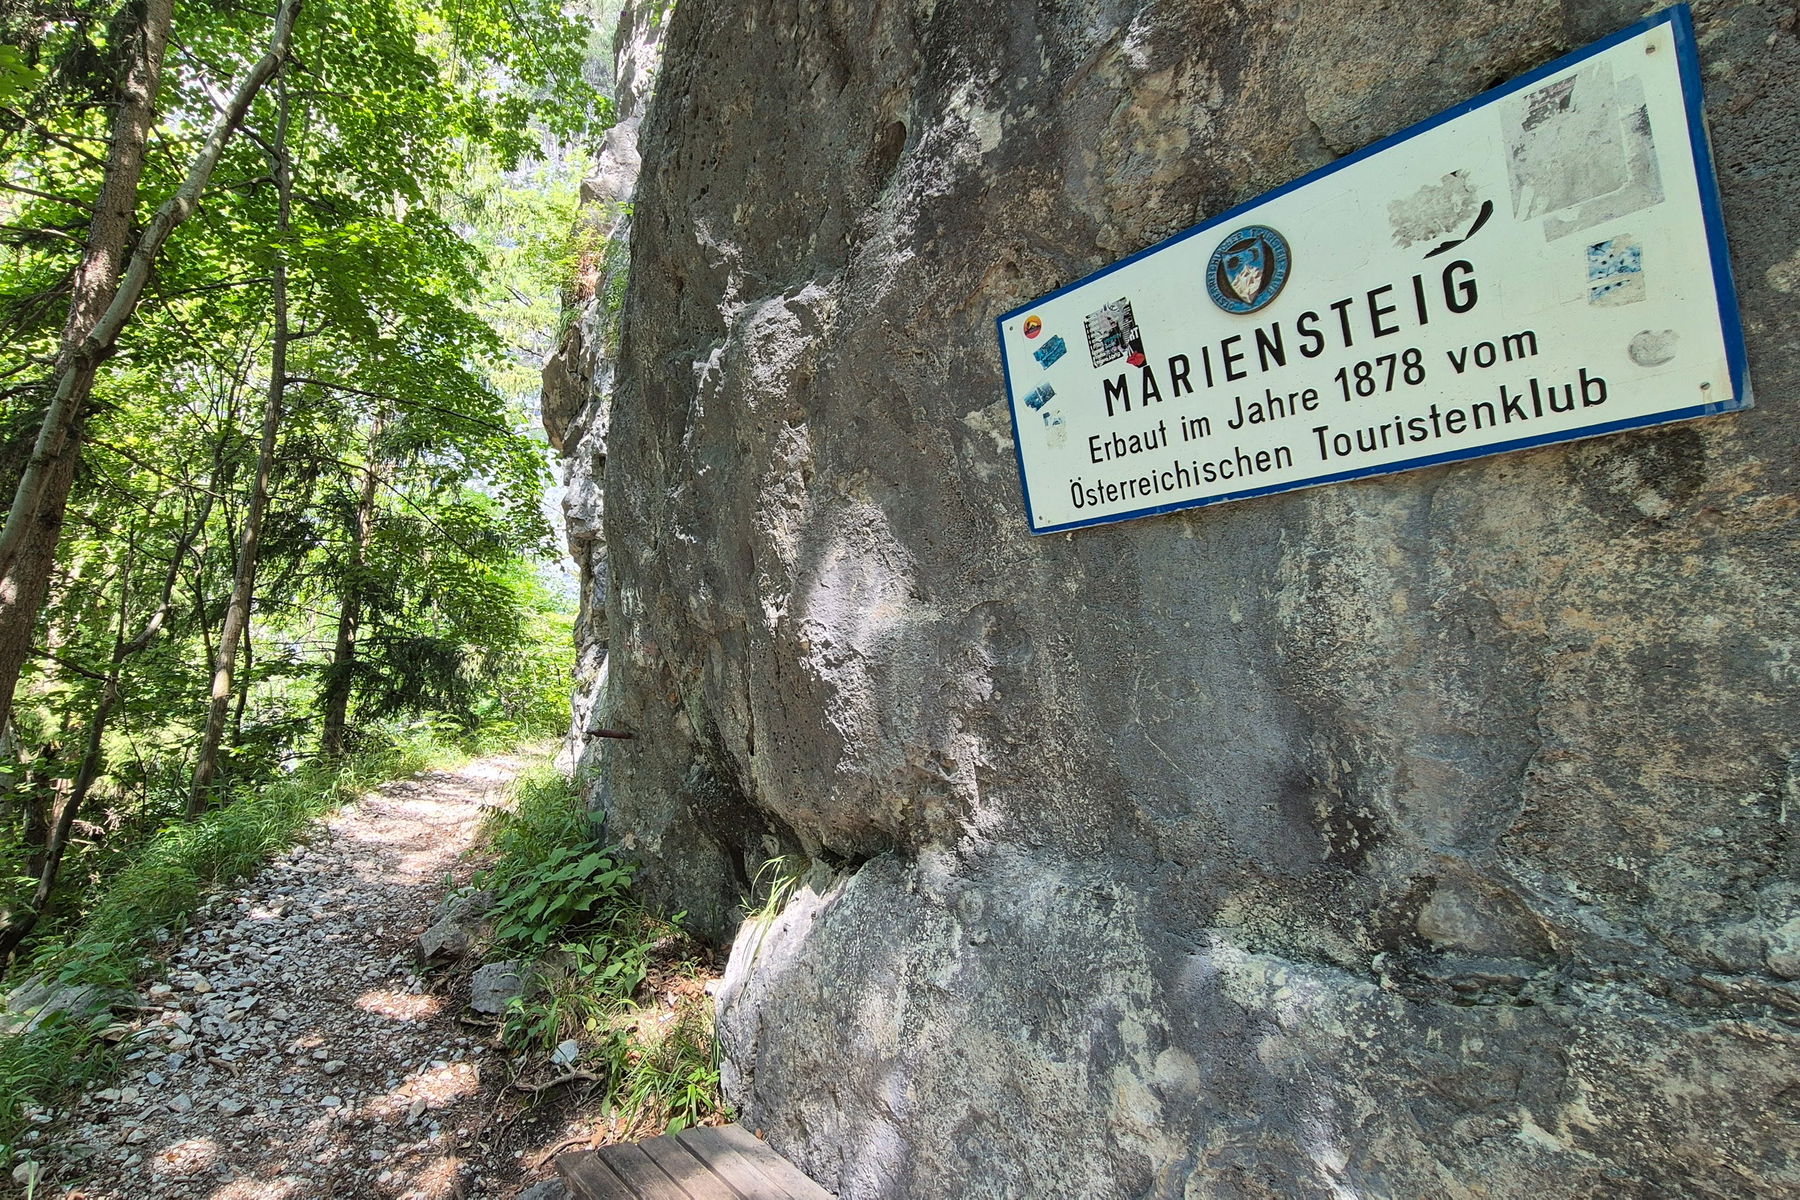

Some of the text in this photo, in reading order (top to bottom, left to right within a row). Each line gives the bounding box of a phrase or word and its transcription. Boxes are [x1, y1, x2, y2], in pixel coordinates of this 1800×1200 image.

[1088, 329, 1539, 464] Erbaut im Jahre 1878 vom
[1102, 258, 1478, 417] MARIENSTEIG
[1069, 367, 1608, 509] Österreichischen Touristenklub
